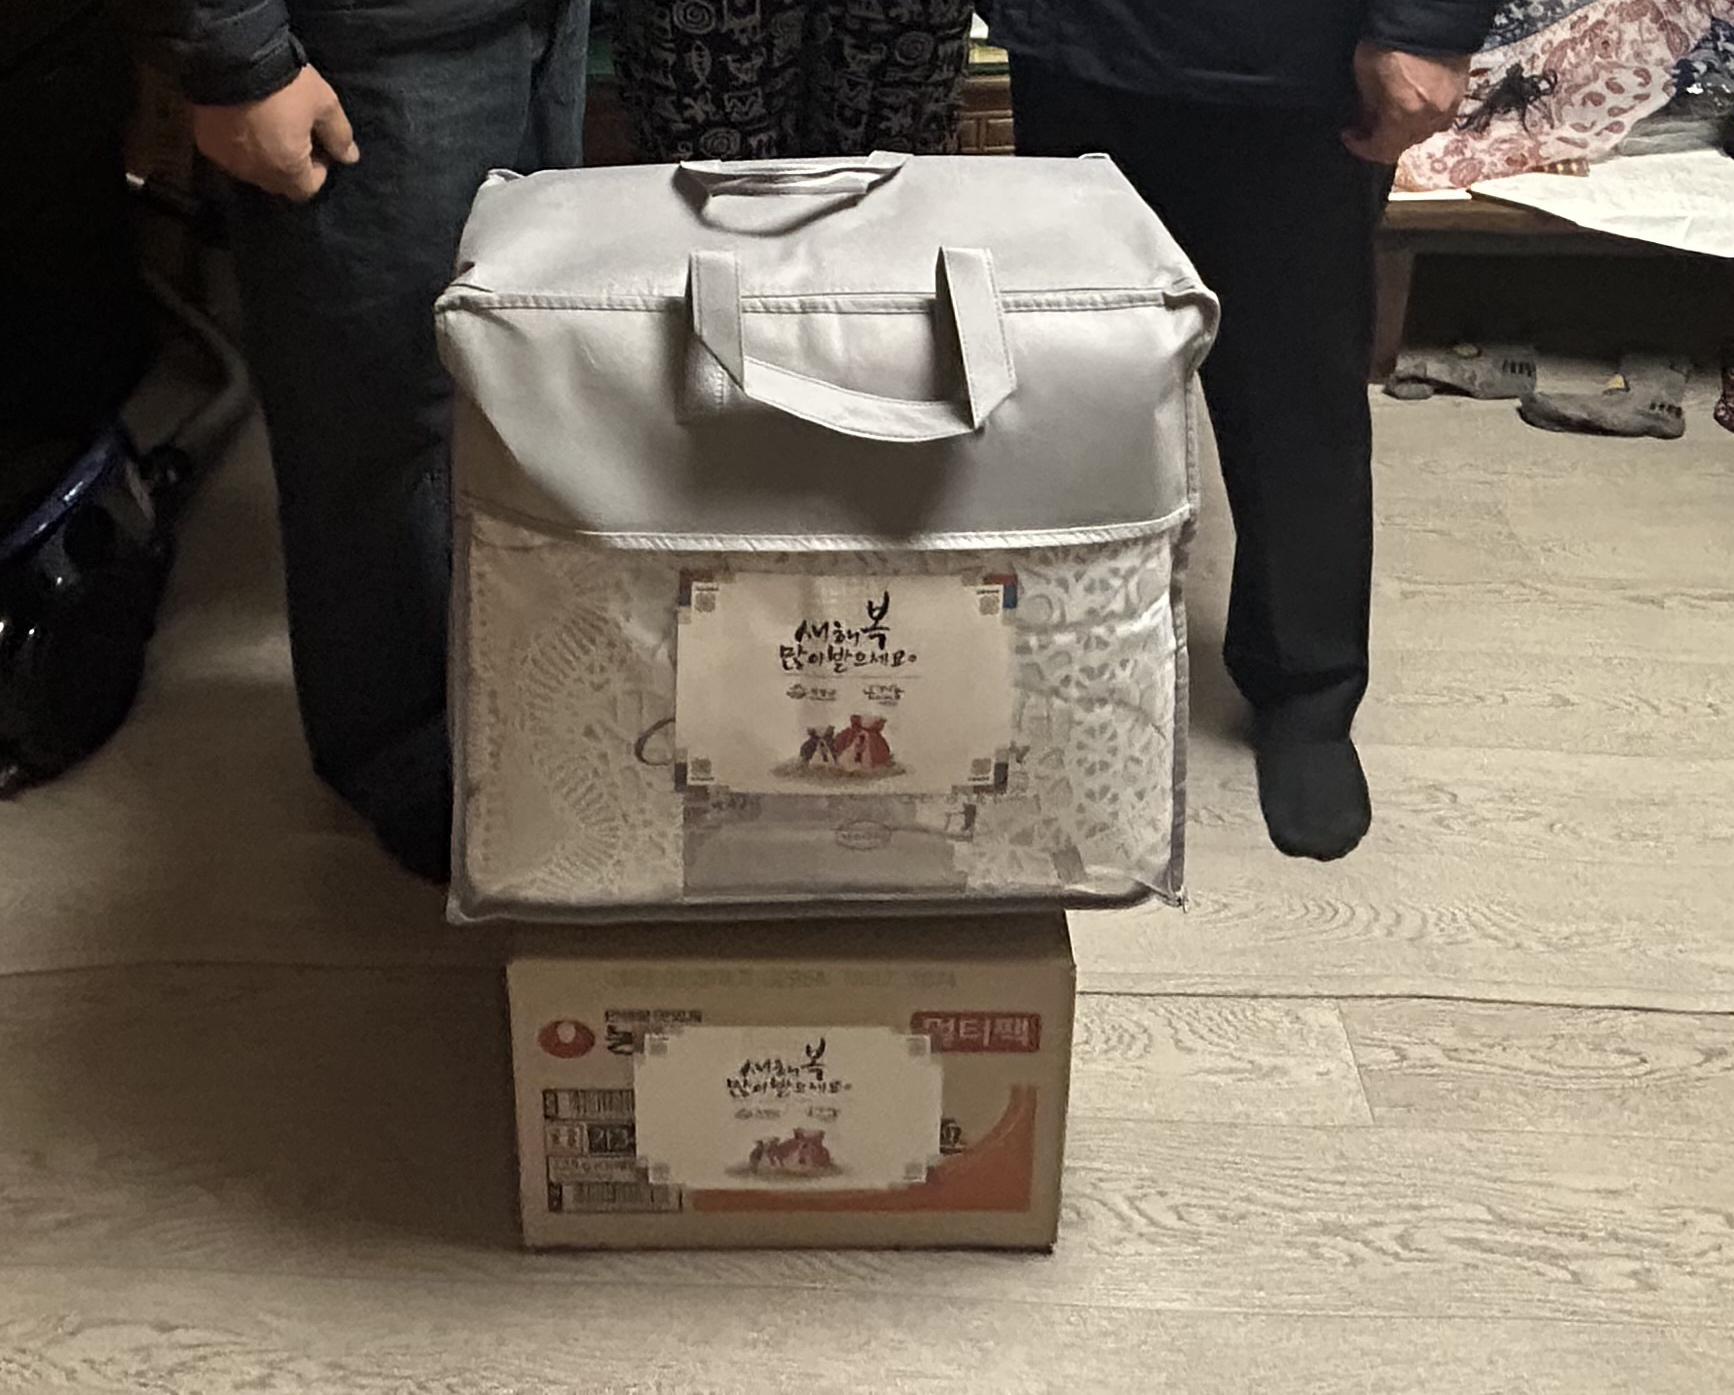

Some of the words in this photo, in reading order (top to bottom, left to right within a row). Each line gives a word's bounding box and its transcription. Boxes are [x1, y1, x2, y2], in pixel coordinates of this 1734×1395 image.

[795, 620, 859, 647] 새해
[860, 590, 891, 649] 복
[779, 644, 824, 671] 많이
[800, 1037, 827, 1081] 복
